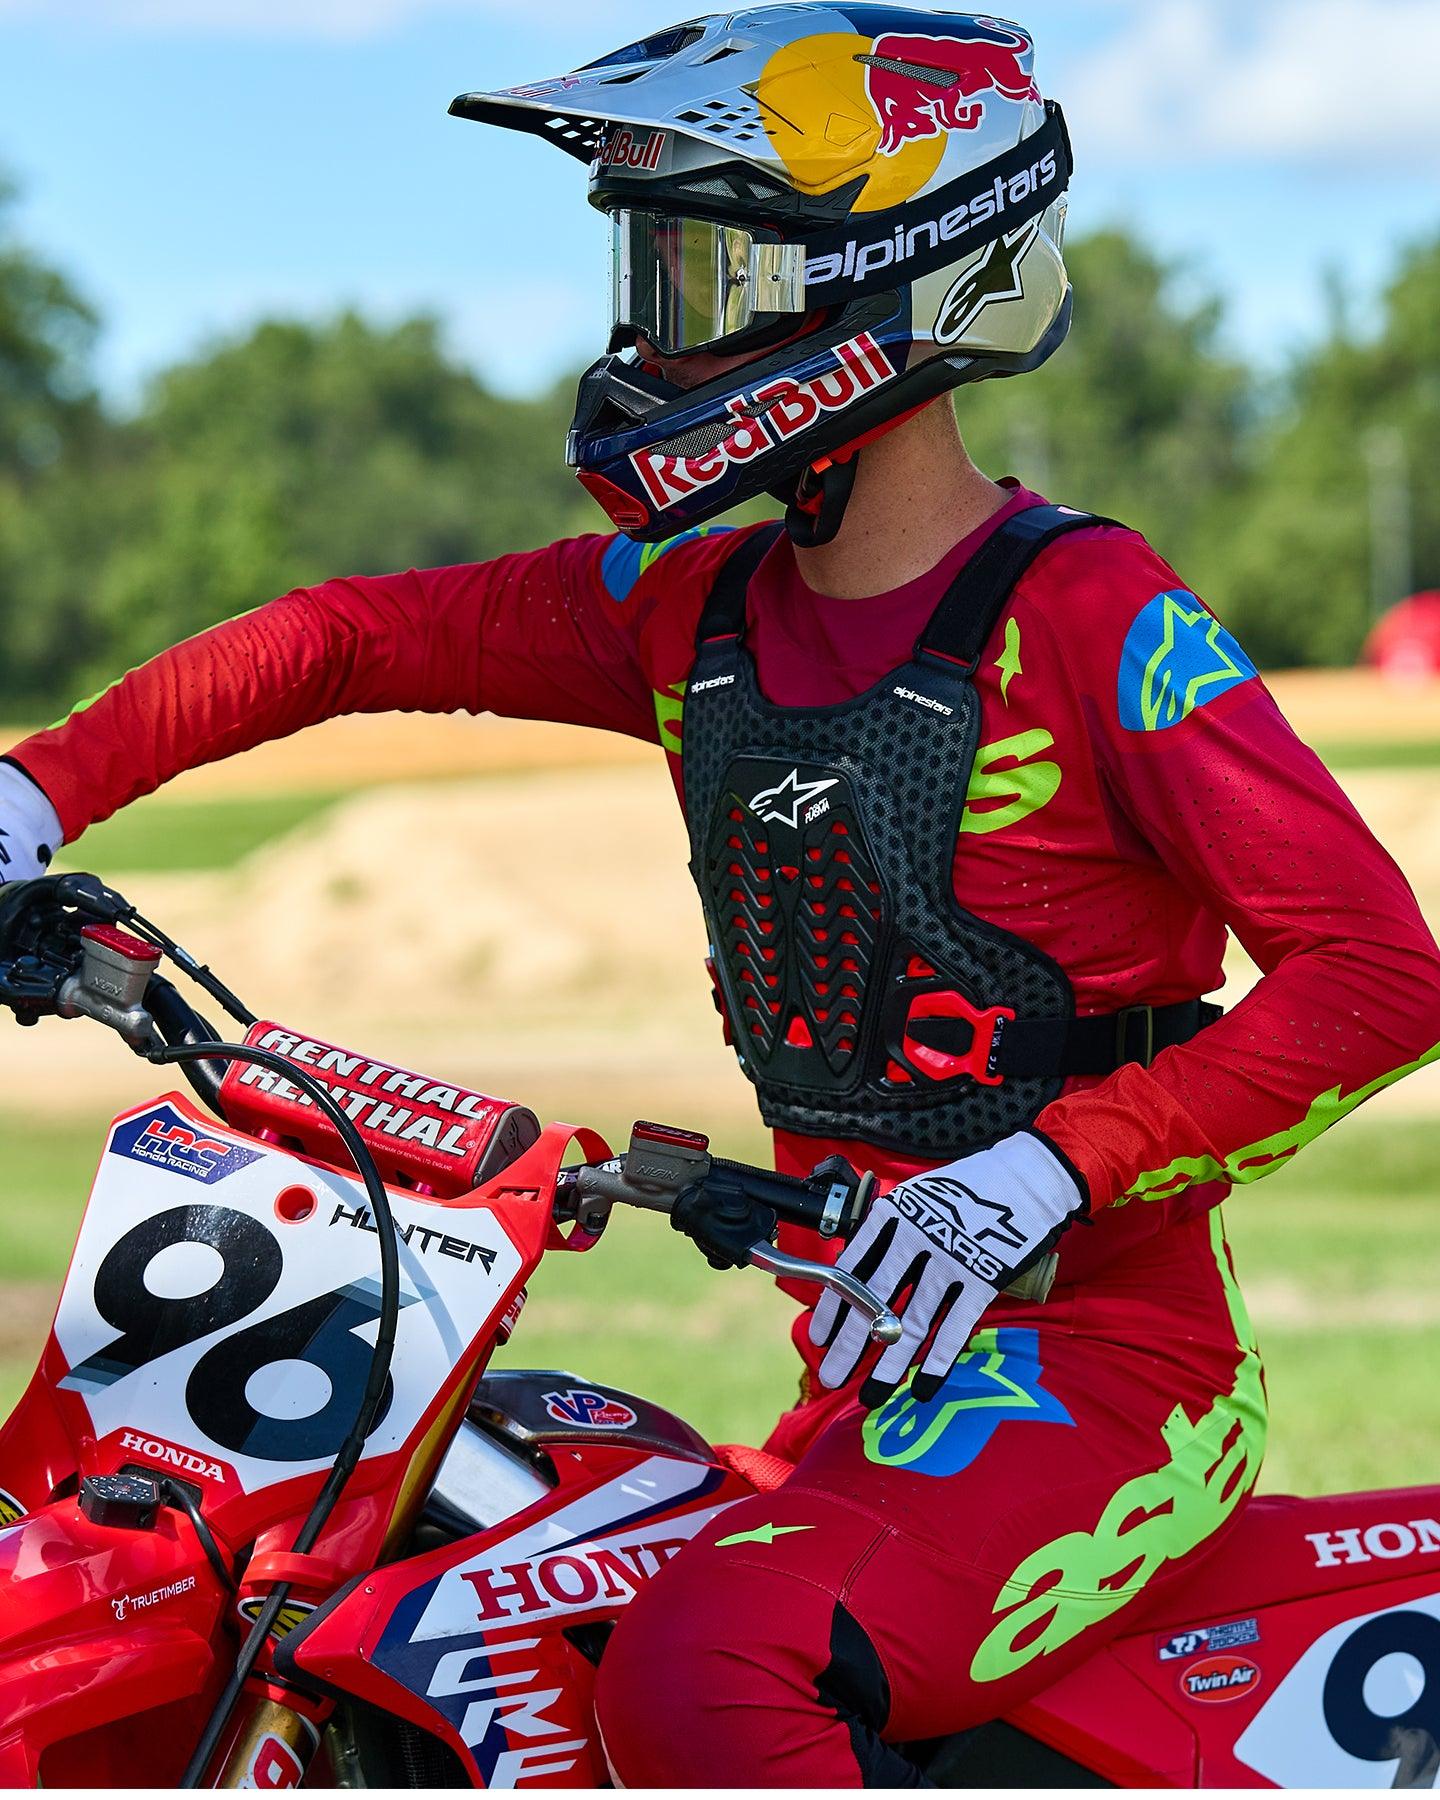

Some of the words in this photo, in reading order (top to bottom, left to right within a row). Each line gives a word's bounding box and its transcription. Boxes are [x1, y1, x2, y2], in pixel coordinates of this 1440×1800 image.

[804, 149, 1056, 285] alpinestars
[691, 675, 735, 693] alpinestars
[893, 686, 954, 716] alpinestars
[131, 1146, 167, 1164] Honda
[167, 1157, 209, 1178] RACING
[889, 1187, 1004, 1281] ASTARS
[57, 1204, 425, 1462] 96
[545, 1391, 608, 1425] VP
[120, 1432, 226, 1483] HONDA
[131, 1576, 196, 1610] TRUETIMBER
[1187, 1673, 1229, 1693] Twin
[1229, 1667, 1255, 1685] Air
